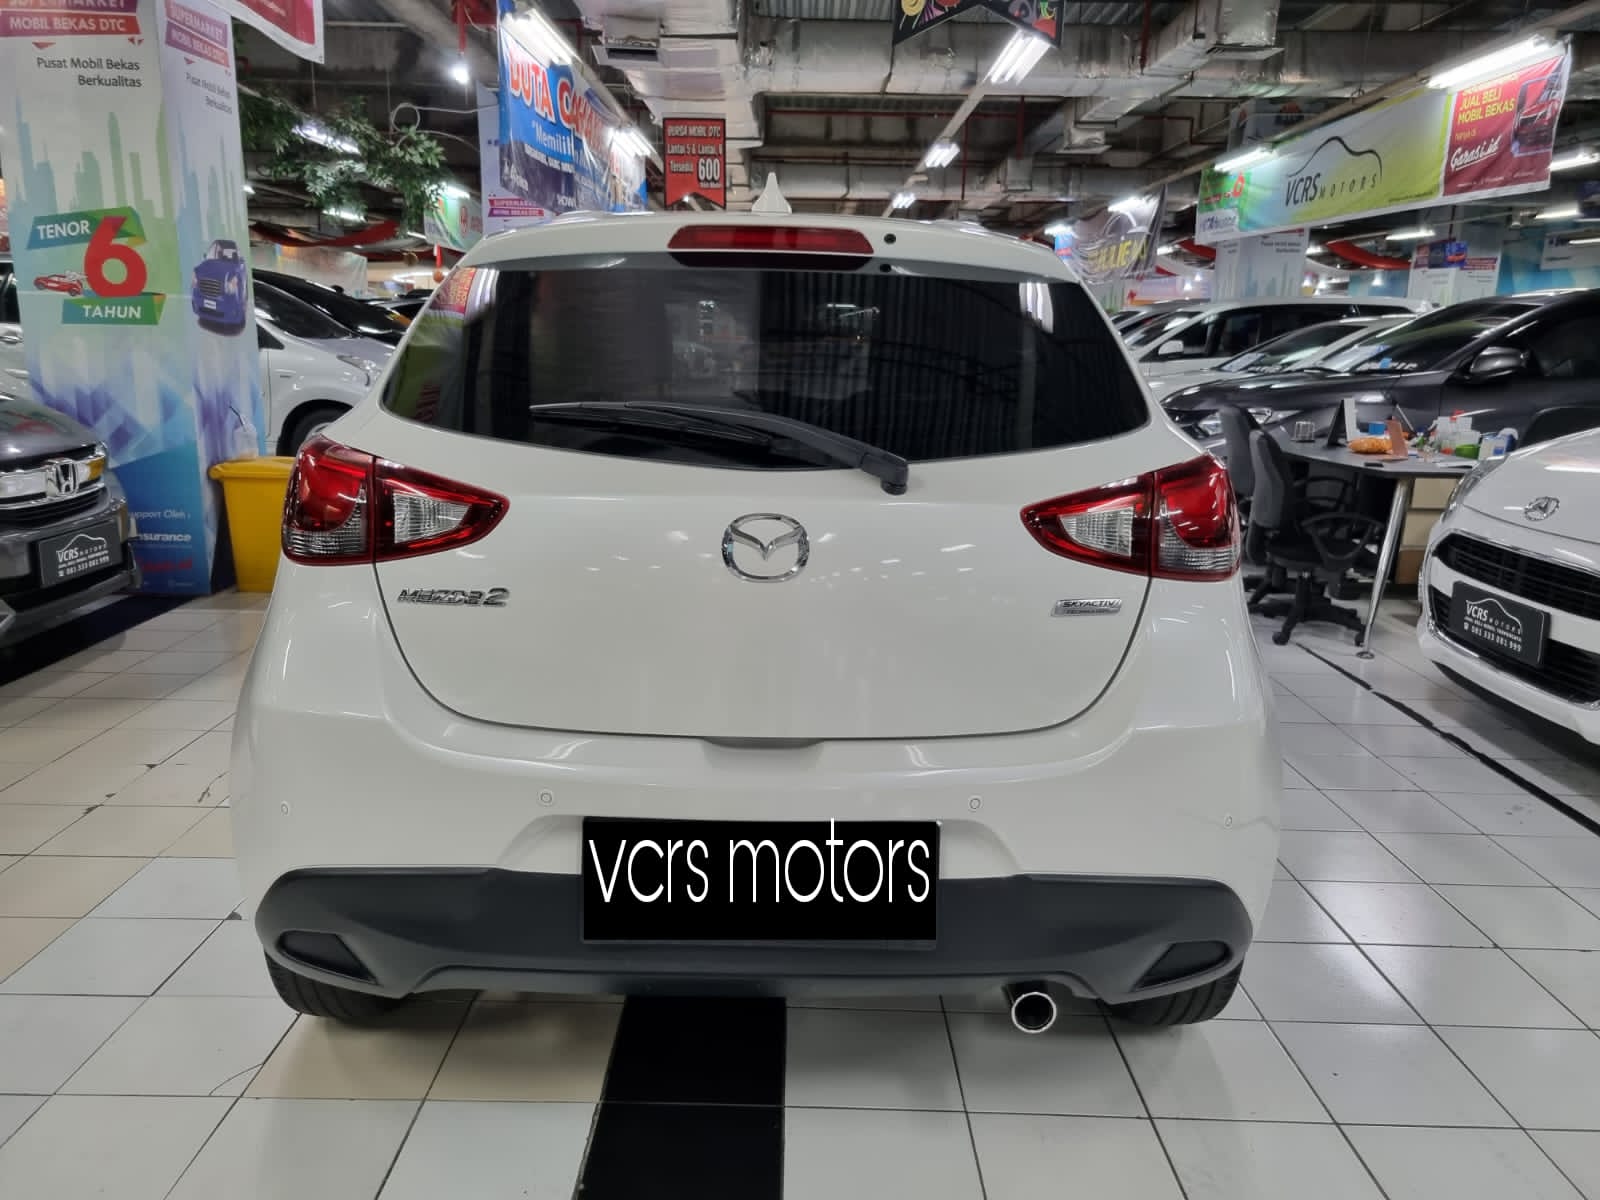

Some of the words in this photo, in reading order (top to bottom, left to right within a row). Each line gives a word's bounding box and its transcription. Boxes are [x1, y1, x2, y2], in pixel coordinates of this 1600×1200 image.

[9, 16, 50, 30] MOBIL
[53, 17, 96, 30] BEKAS
[99, 19, 126, 31] DTC
[37, 57, 67, 69] Pusat
[70, 58, 102, 69] Mobil
[106, 59, 140, 71] Bekas
[78, 75, 142, 88] Berkualitas
[1460, 95, 1481, 110] JUAL
[1457, 107, 1483, 125] MOBIL
[1485, 98, 1516, 117] BEKAS
[698, 158, 720, 180] 600
[1285, 172, 1321, 207] VCRS
[1320, 174, 1377, 199] MOTORS
[37, 220, 91, 240] TENOR
[84, 215, 147, 297] 6
[82, 305, 141, 319] TAHUN
[57, 547, 79, 562] VCRS
[1466, 602, 1489, 621] VCRS
